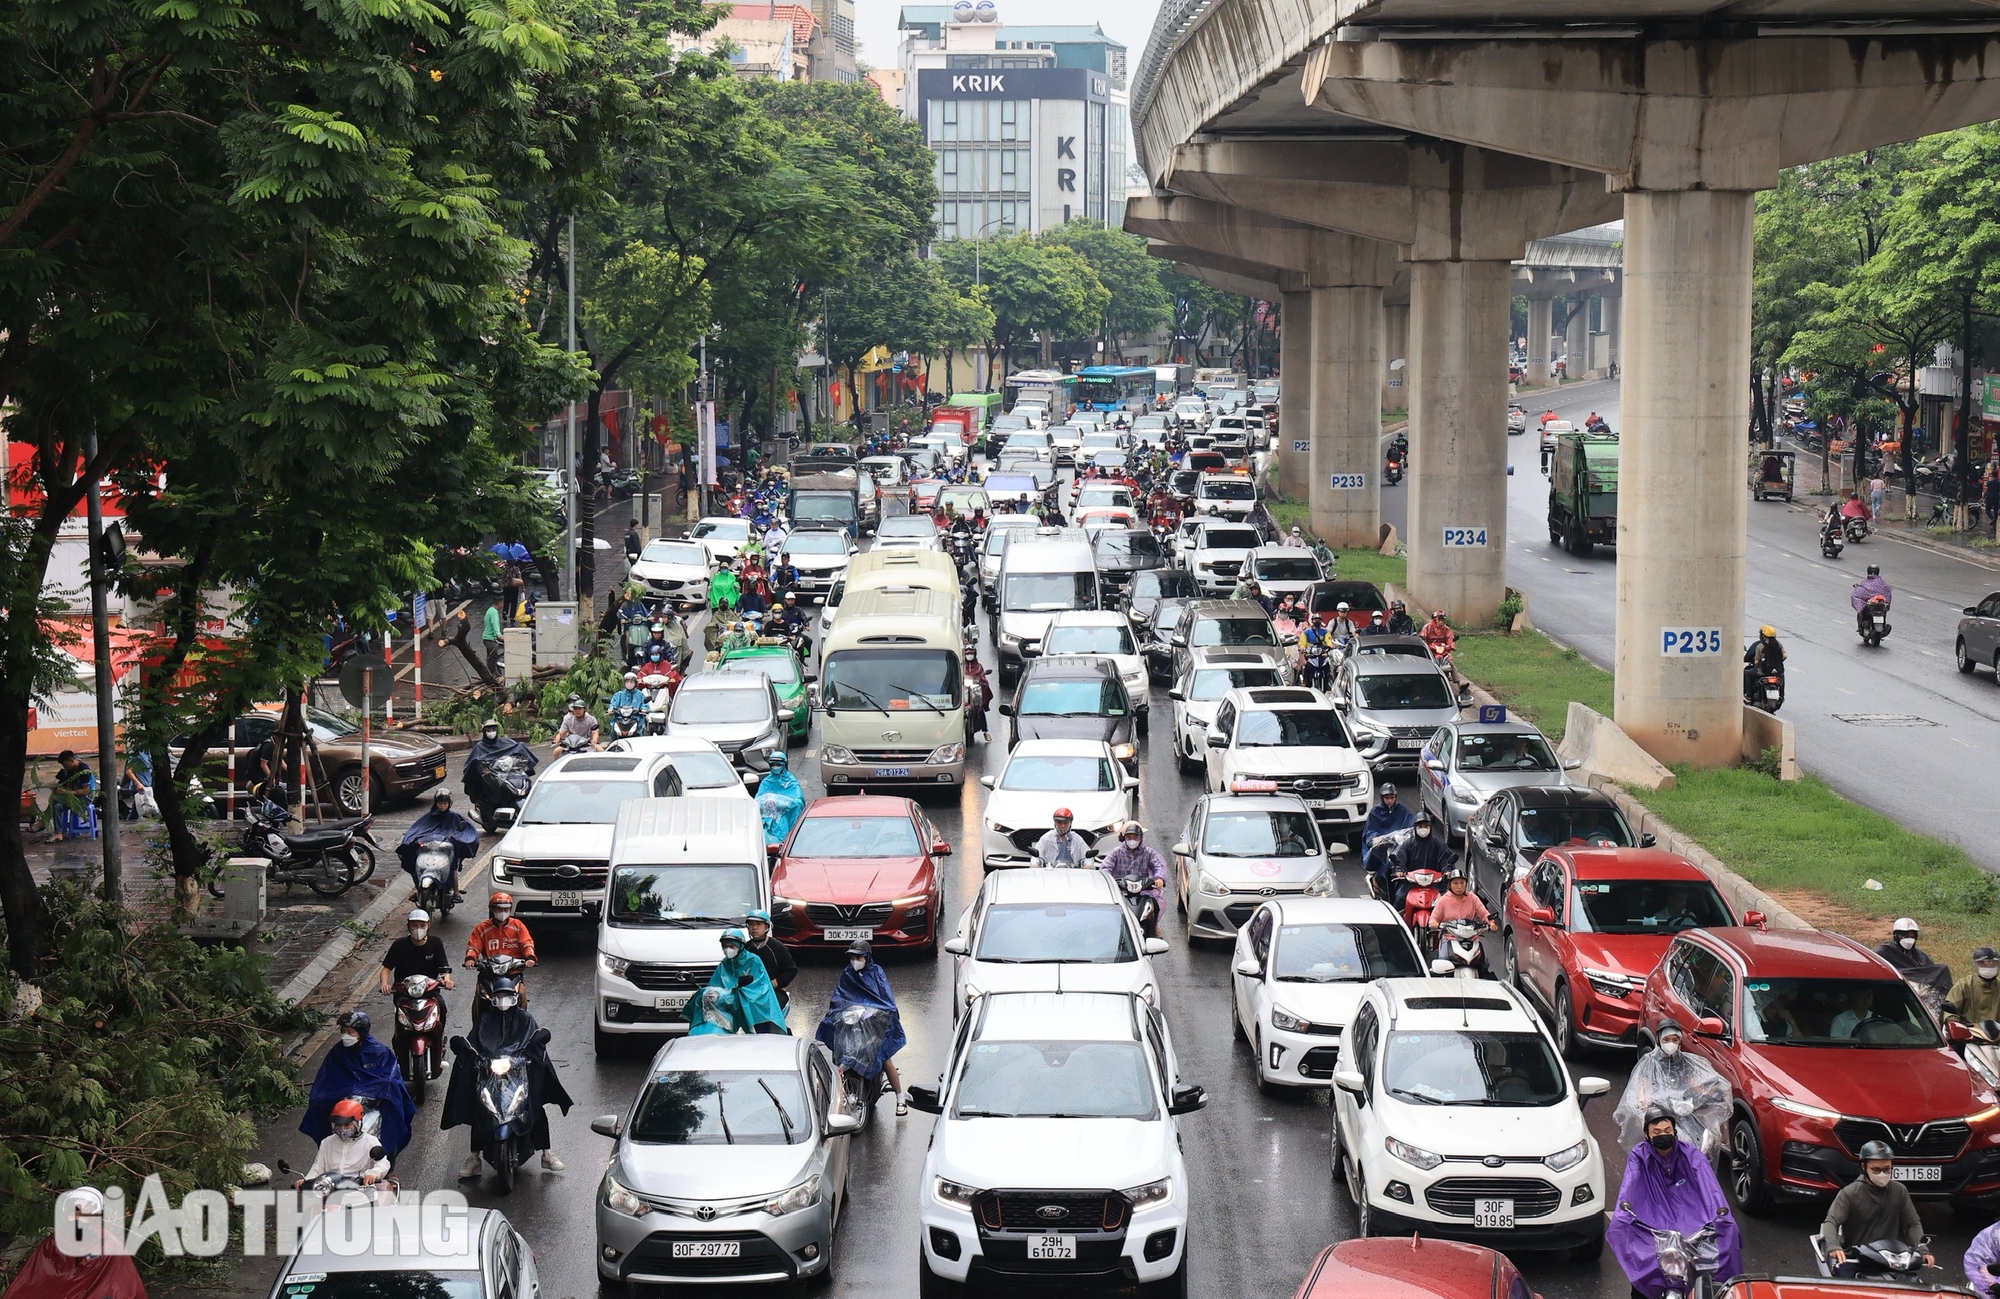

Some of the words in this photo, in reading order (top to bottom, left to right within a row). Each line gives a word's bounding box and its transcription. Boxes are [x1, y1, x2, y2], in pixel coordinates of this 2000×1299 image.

[952, 75, 1005, 92] KRIK
[1332, 475, 1364, 488] P233
[1444, 529, 1487, 546] P234
[1663, 630, 1720, 653] P235
[1485, 707, 1500, 721] G7
[53, 729, 88, 737] viettel
[828, 931, 869, 939] 30K-735.46
[1043, 1207, 1062, 1217] Ford
[1483, 1201, 1505, 1213] 30F
[1475, 1214, 1513, 1227] 919.85
[1041, 1236, 1063, 1247] 29H
[674, 1243, 738, 1256] 30F-297.72
[1032, 1247, 1071, 1258] 610.72
